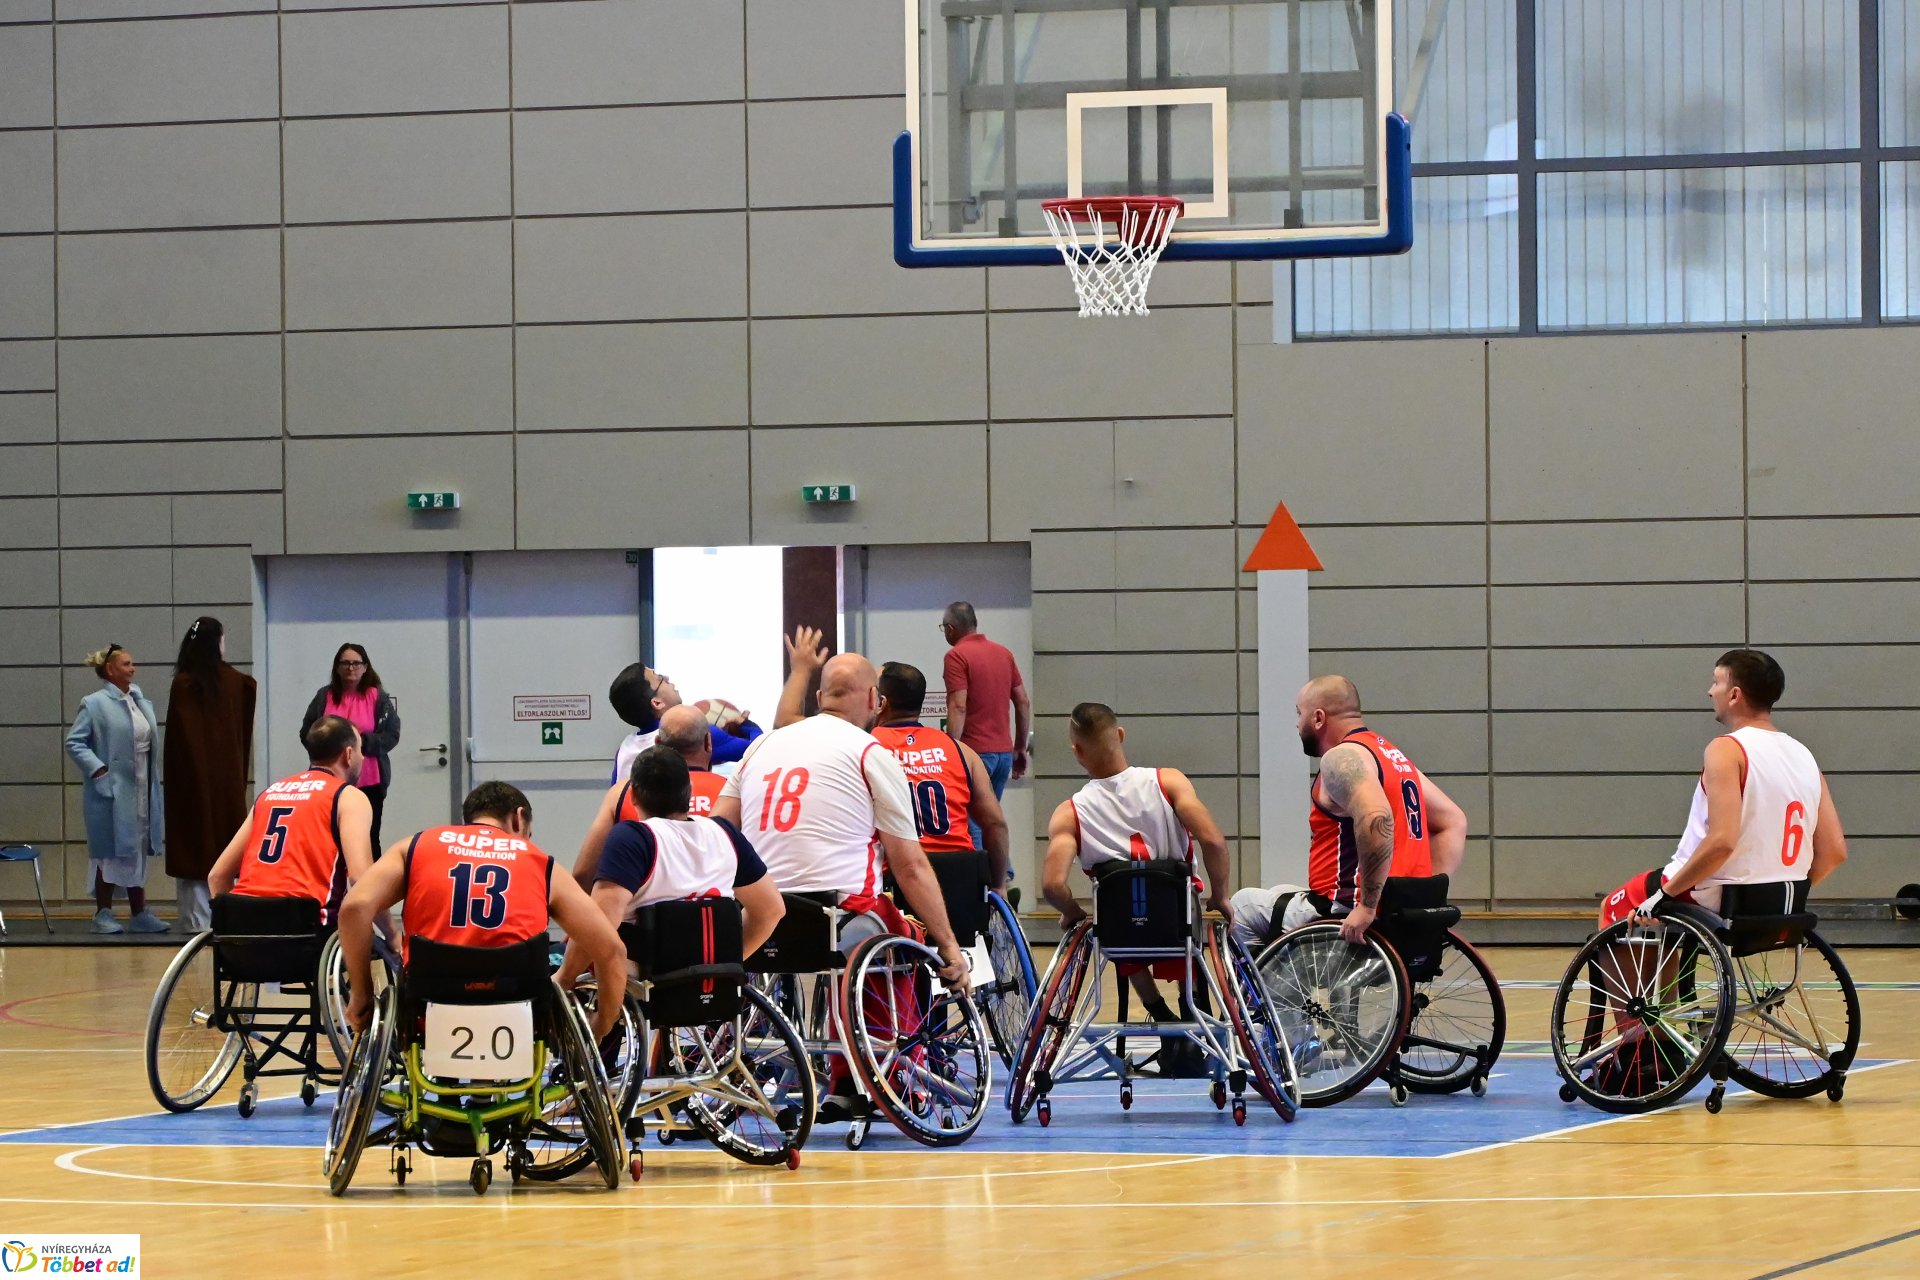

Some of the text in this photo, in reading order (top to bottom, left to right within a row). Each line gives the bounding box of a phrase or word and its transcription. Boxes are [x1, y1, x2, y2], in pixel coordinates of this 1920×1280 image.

[264, 792, 311, 801] FOUNDATION
[265, 780, 326, 793] SUPER
[759, 766, 810, 833] 18
[257, 806, 296, 865] 5
[438, 830, 528, 851] SUPER
[1781, 800, 1804, 867] 6
[447, 845, 517, 861] FOUNDATION
[447, 861, 511, 930] 13
[450, 1025, 515, 1061] 2.0
